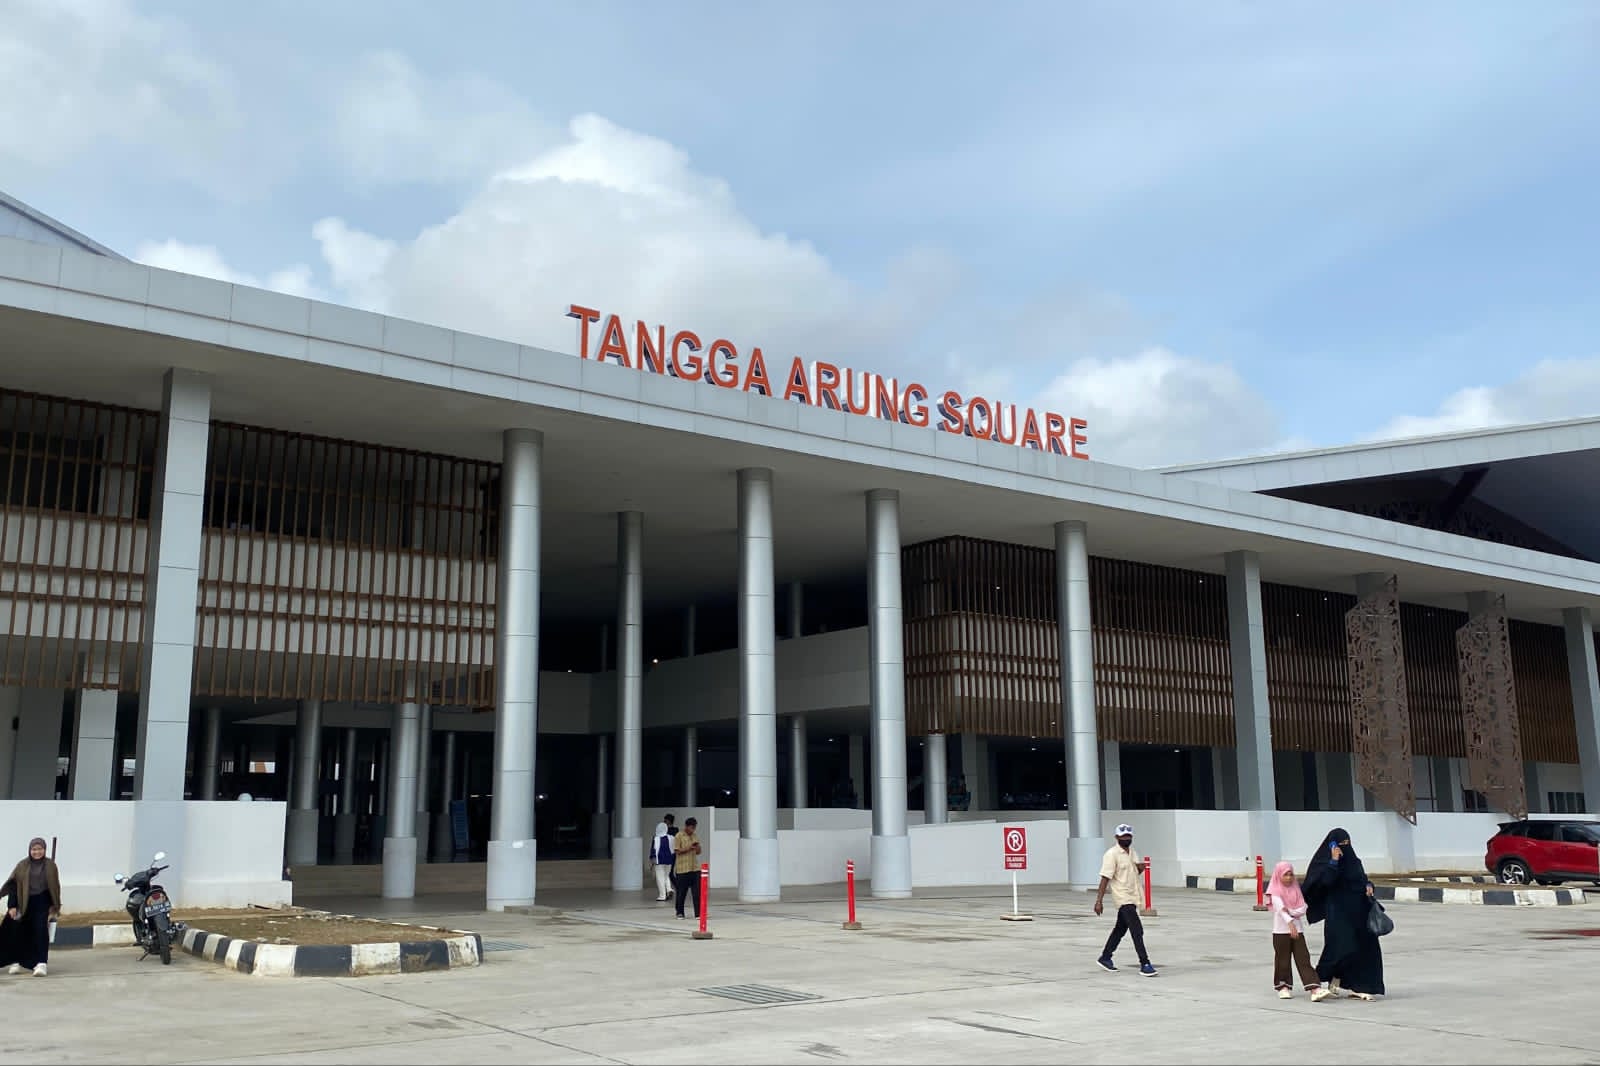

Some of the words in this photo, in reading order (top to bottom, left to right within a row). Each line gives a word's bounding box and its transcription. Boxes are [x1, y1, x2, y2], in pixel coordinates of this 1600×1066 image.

[567, 304, 772, 397] TANGGA
[784, 356, 929, 427] ARUNG
[938, 390, 1089, 461] SQUARE
